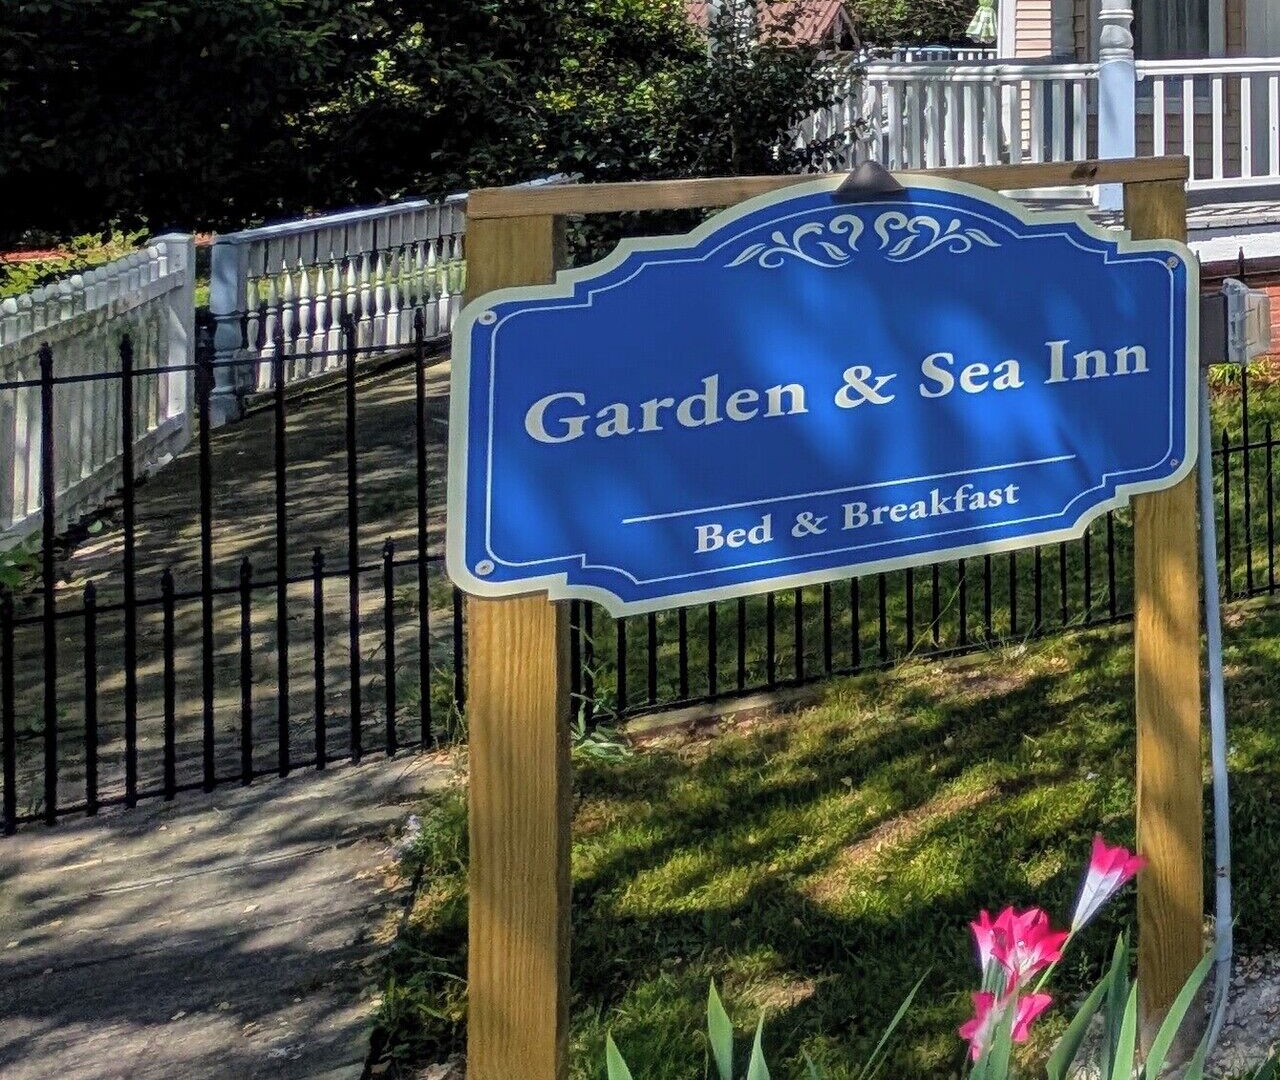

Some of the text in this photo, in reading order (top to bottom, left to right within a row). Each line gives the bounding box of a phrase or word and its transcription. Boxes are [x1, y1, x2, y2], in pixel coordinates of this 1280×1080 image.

[524, 339, 1149, 443] Garden & Sea Inn
[694, 483, 1020, 553] Bed & Breakfast
